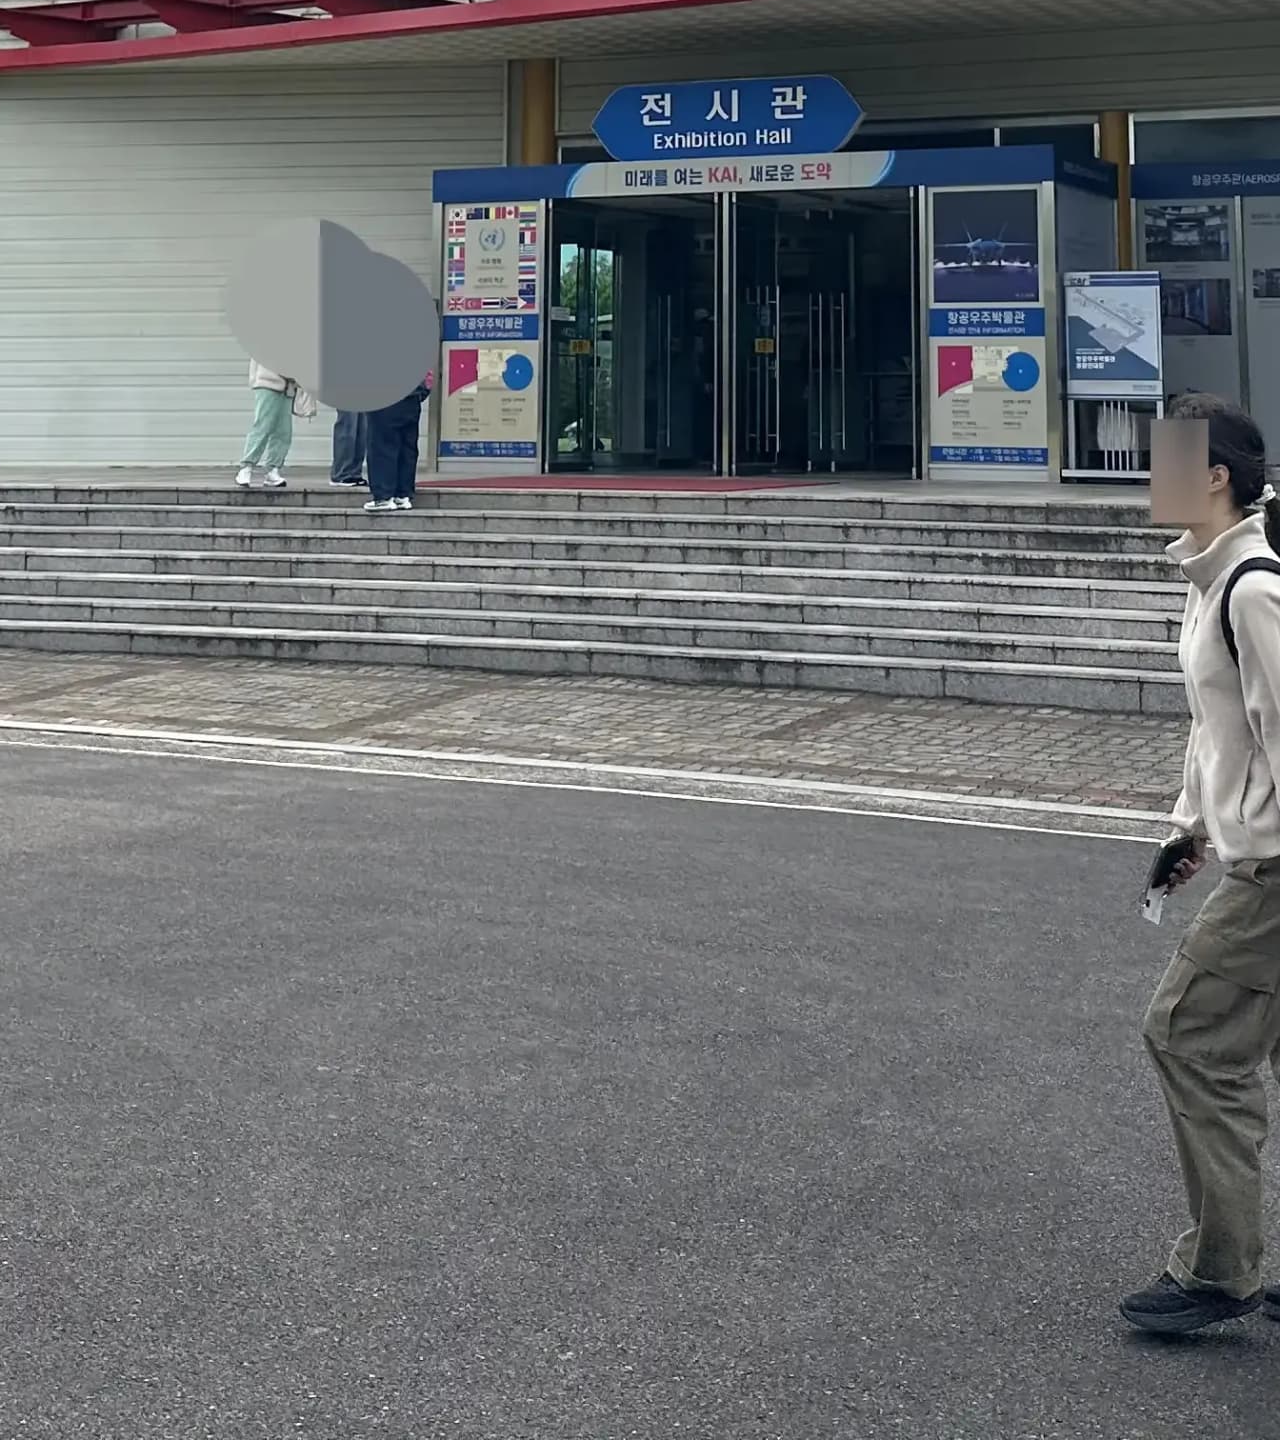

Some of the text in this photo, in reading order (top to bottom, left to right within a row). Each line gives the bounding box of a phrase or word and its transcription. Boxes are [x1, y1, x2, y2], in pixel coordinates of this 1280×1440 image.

[653, 127, 792, 150] Exhibition Hall
[624, 162, 832, 187] 미래를 여는 KAI, 새로운 도약
[947, 310, 1026, 325] 항공우주박물관
